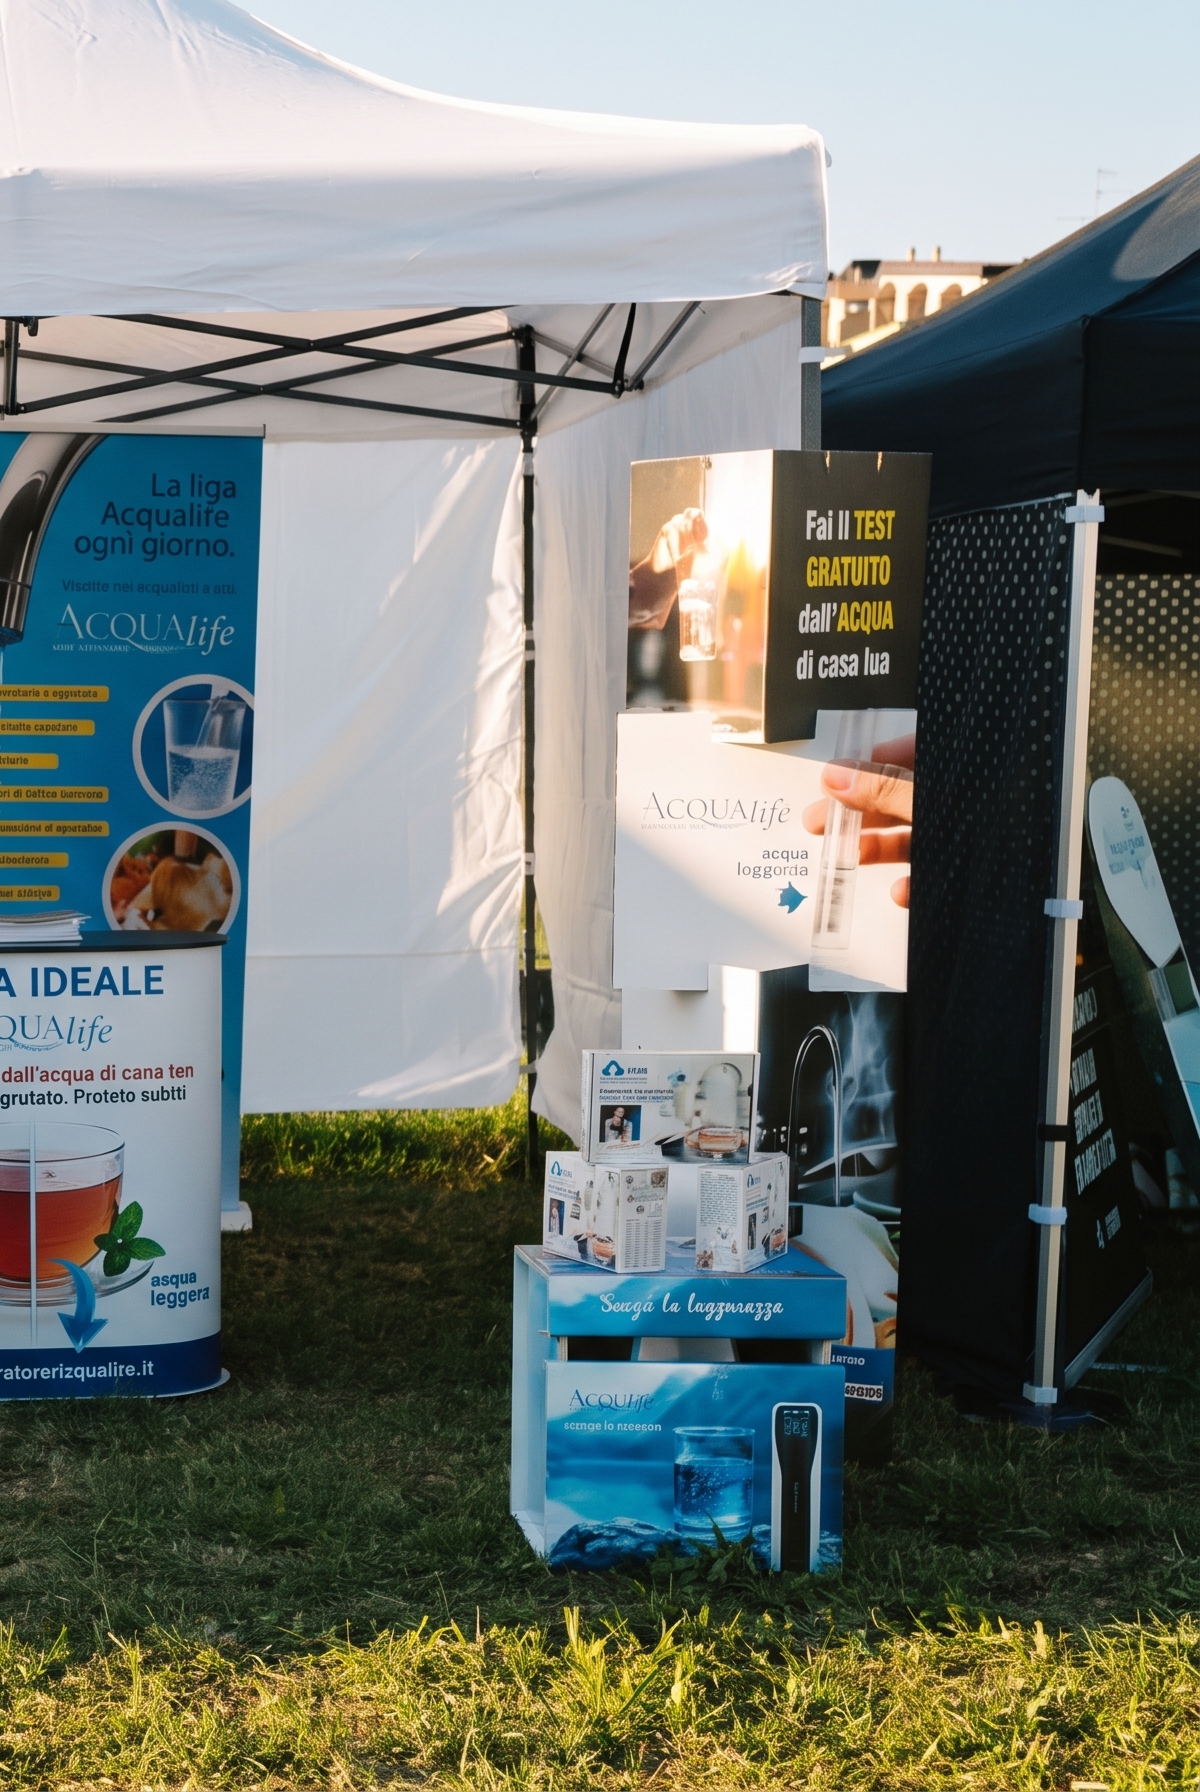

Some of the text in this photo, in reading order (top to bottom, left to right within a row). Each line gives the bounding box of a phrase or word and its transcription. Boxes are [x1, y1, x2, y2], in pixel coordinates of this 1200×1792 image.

[152, 473, 237, 505] La liga
[806, 510, 833, 540] Fai
[854, 510, 896, 540] TEST
[141, 531, 236, 562] giorno.
[806, 555, 891, 588] GRATUITO
[52, 603, 235, 656] ACQUAlife
[796, 650, 813, 680] di
[818, 653, 858, 679] casa
[641, 792, 790, 830] ACQUAlife
[762, 850, 808, 862] acqua
[31, 965, 164, 997] IDEALE
[1, 1066, 94, 1086] dall'acqua
[100, 1065, 116, 1081] di
[122, 1067, 164, 1080] cana
[168, 1064, 195, 1079] ten
[0, 1091, 69, 1110] grutato.
[74, 1089, 136, 1104] Proteto
[151, 1272, 197, 1289] asqua
[151, 1287, 210, 1309] leggera
